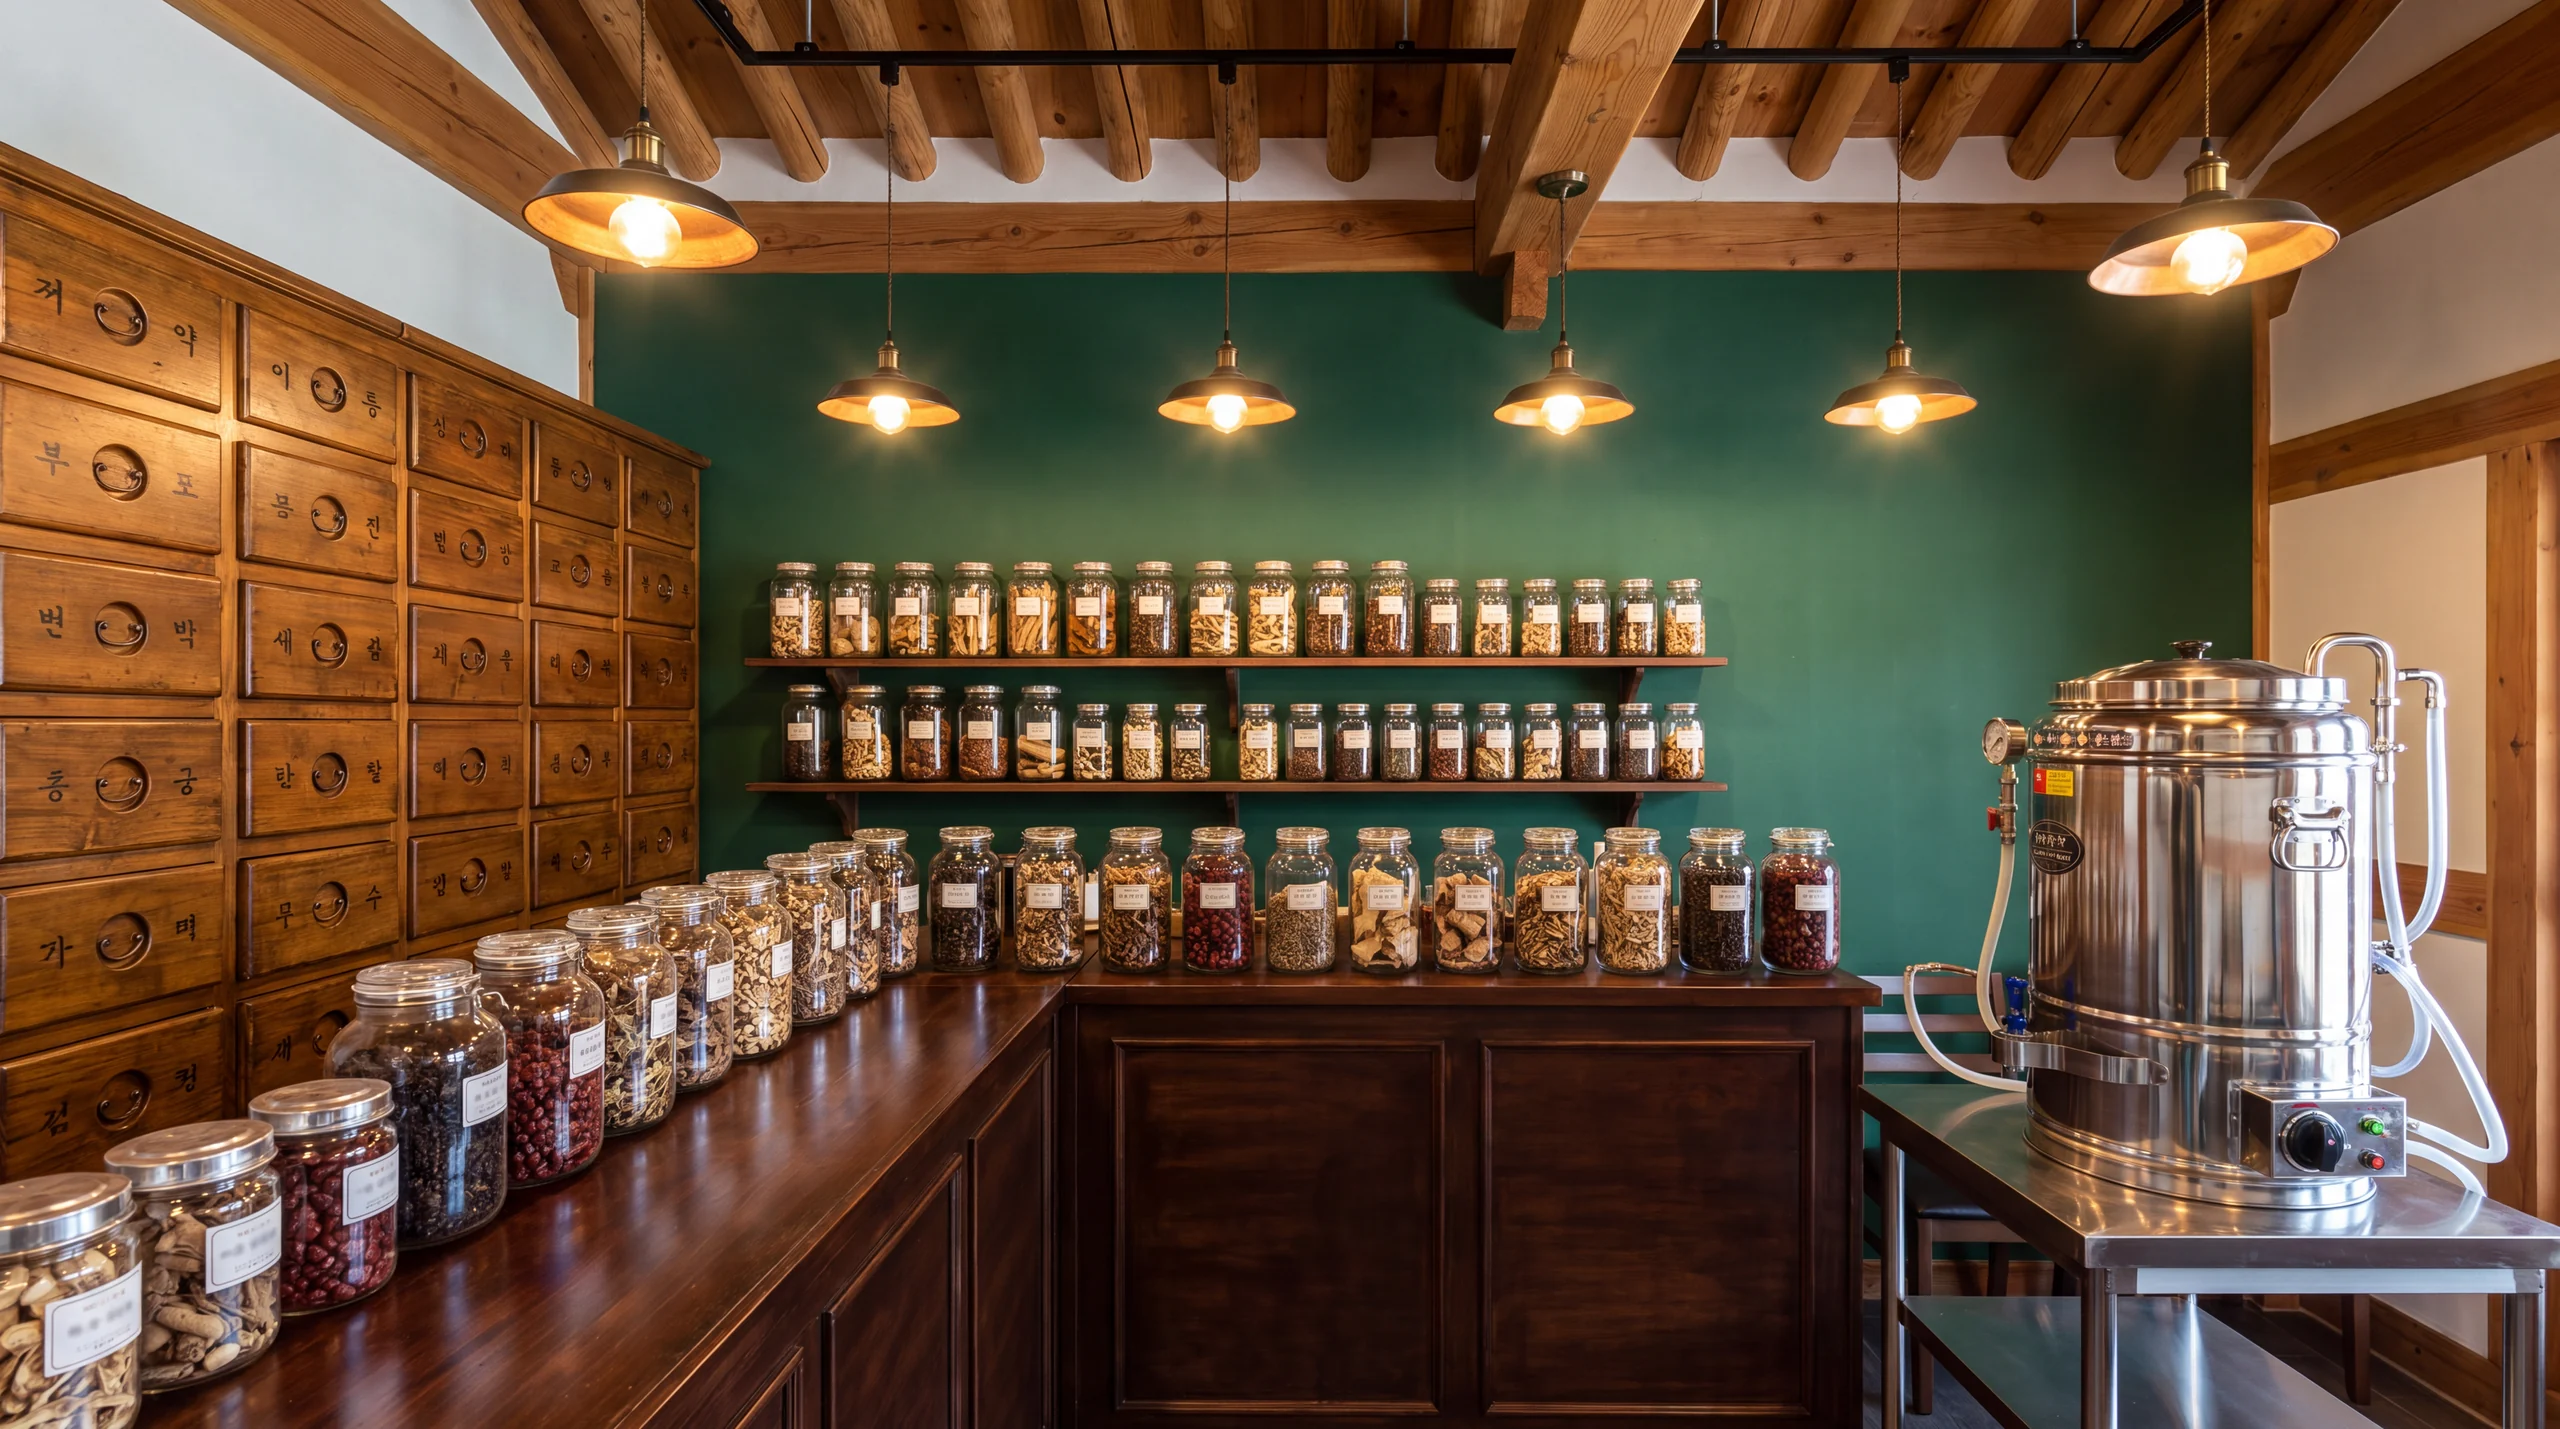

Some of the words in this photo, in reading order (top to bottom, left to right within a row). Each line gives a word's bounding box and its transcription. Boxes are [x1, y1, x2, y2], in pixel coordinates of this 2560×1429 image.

[173, 325, 197, 357] 약
[272, 362, 289, 390] 이
[35, 442, 69, 476] 부
[366, 516, 380, 539] 진
[174, 619, 196, 649] 박
[173, 767, 197, 795] 궁
[276, 902, 294, 929] 무
[366, 885, 382, 910] 수
